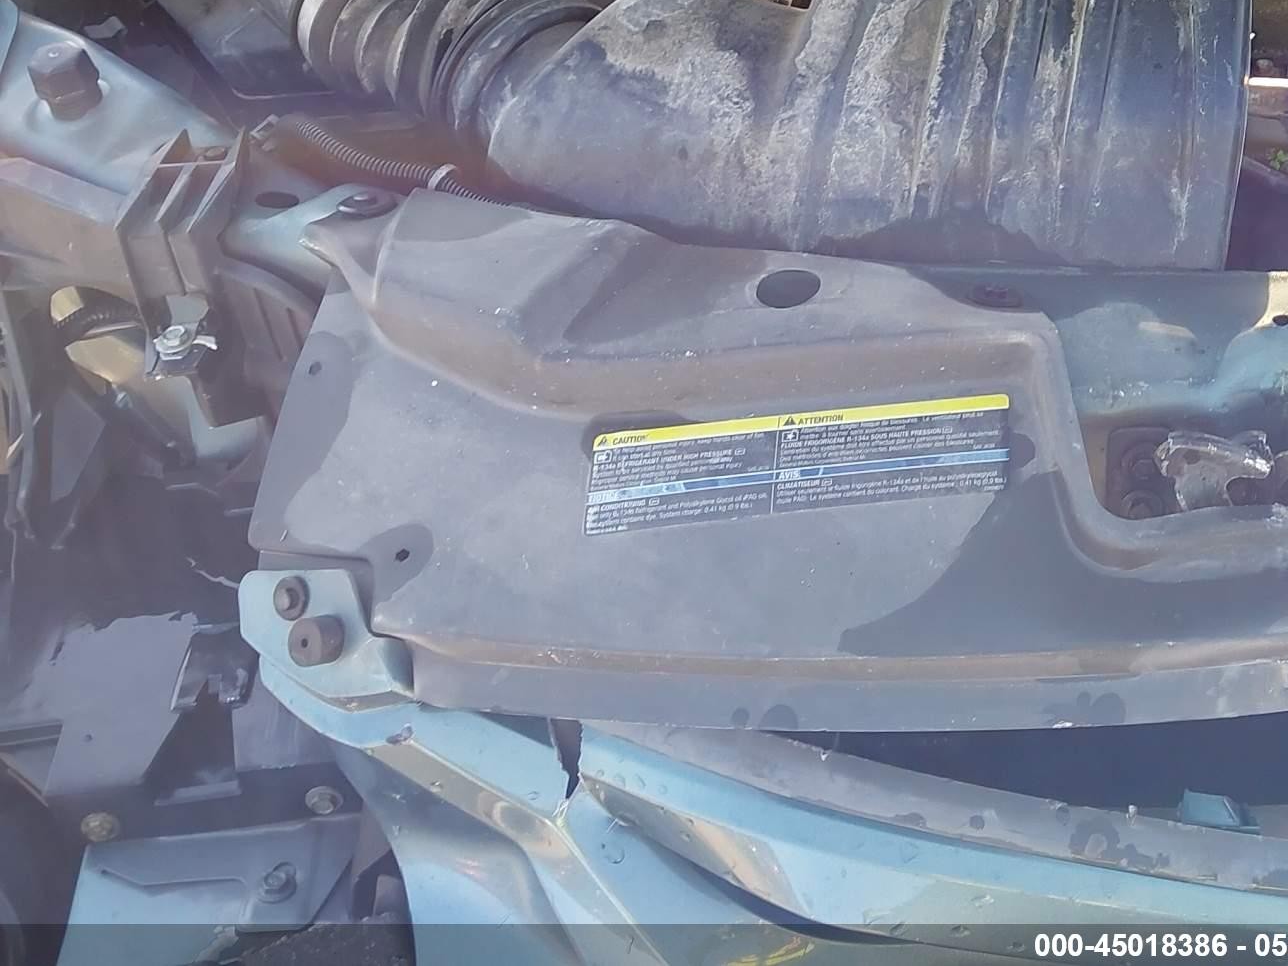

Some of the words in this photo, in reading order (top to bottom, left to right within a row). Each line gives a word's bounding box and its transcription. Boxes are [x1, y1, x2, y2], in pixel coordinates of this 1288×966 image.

[798, 414, 843, 425] ATTENTION
[910, 427, 941, 435] PRESSION
[778, 470, 798, 479] AVIS
